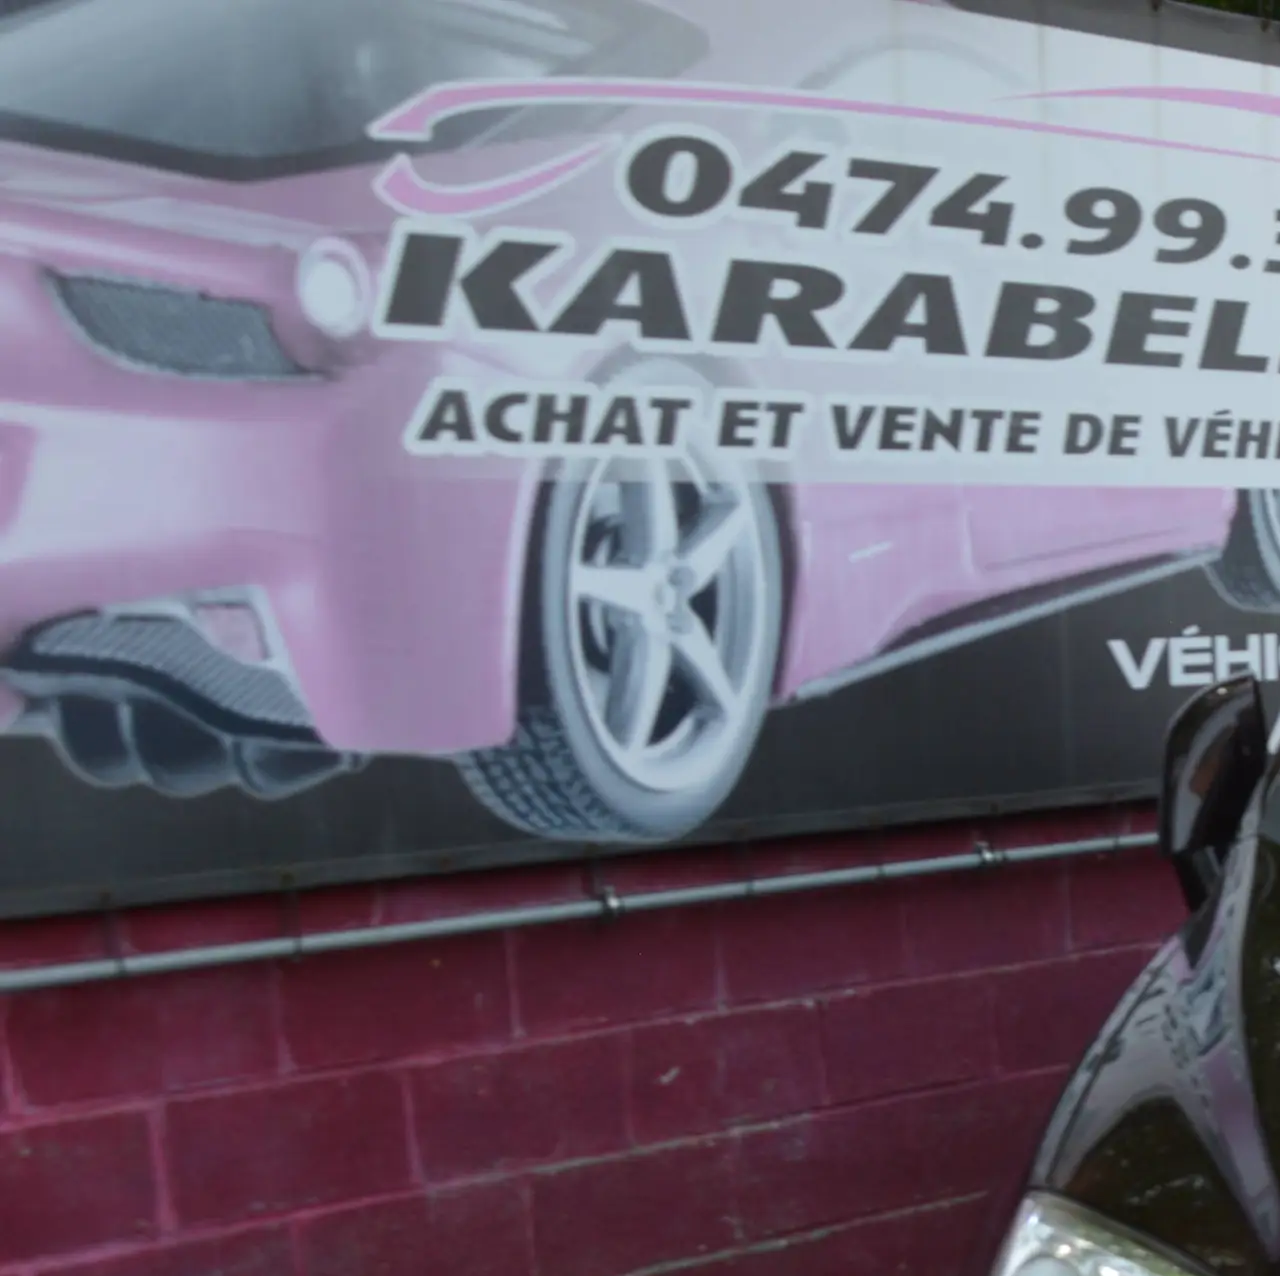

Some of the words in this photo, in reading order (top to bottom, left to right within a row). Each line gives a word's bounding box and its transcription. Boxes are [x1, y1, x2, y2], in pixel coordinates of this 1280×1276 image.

[416, 388, 693, 447] ACHAT
[716, 400, 806, 450] ET
[830, 403, 1043, 455] VENTE
[1063, 412, 1142, 456] DE
